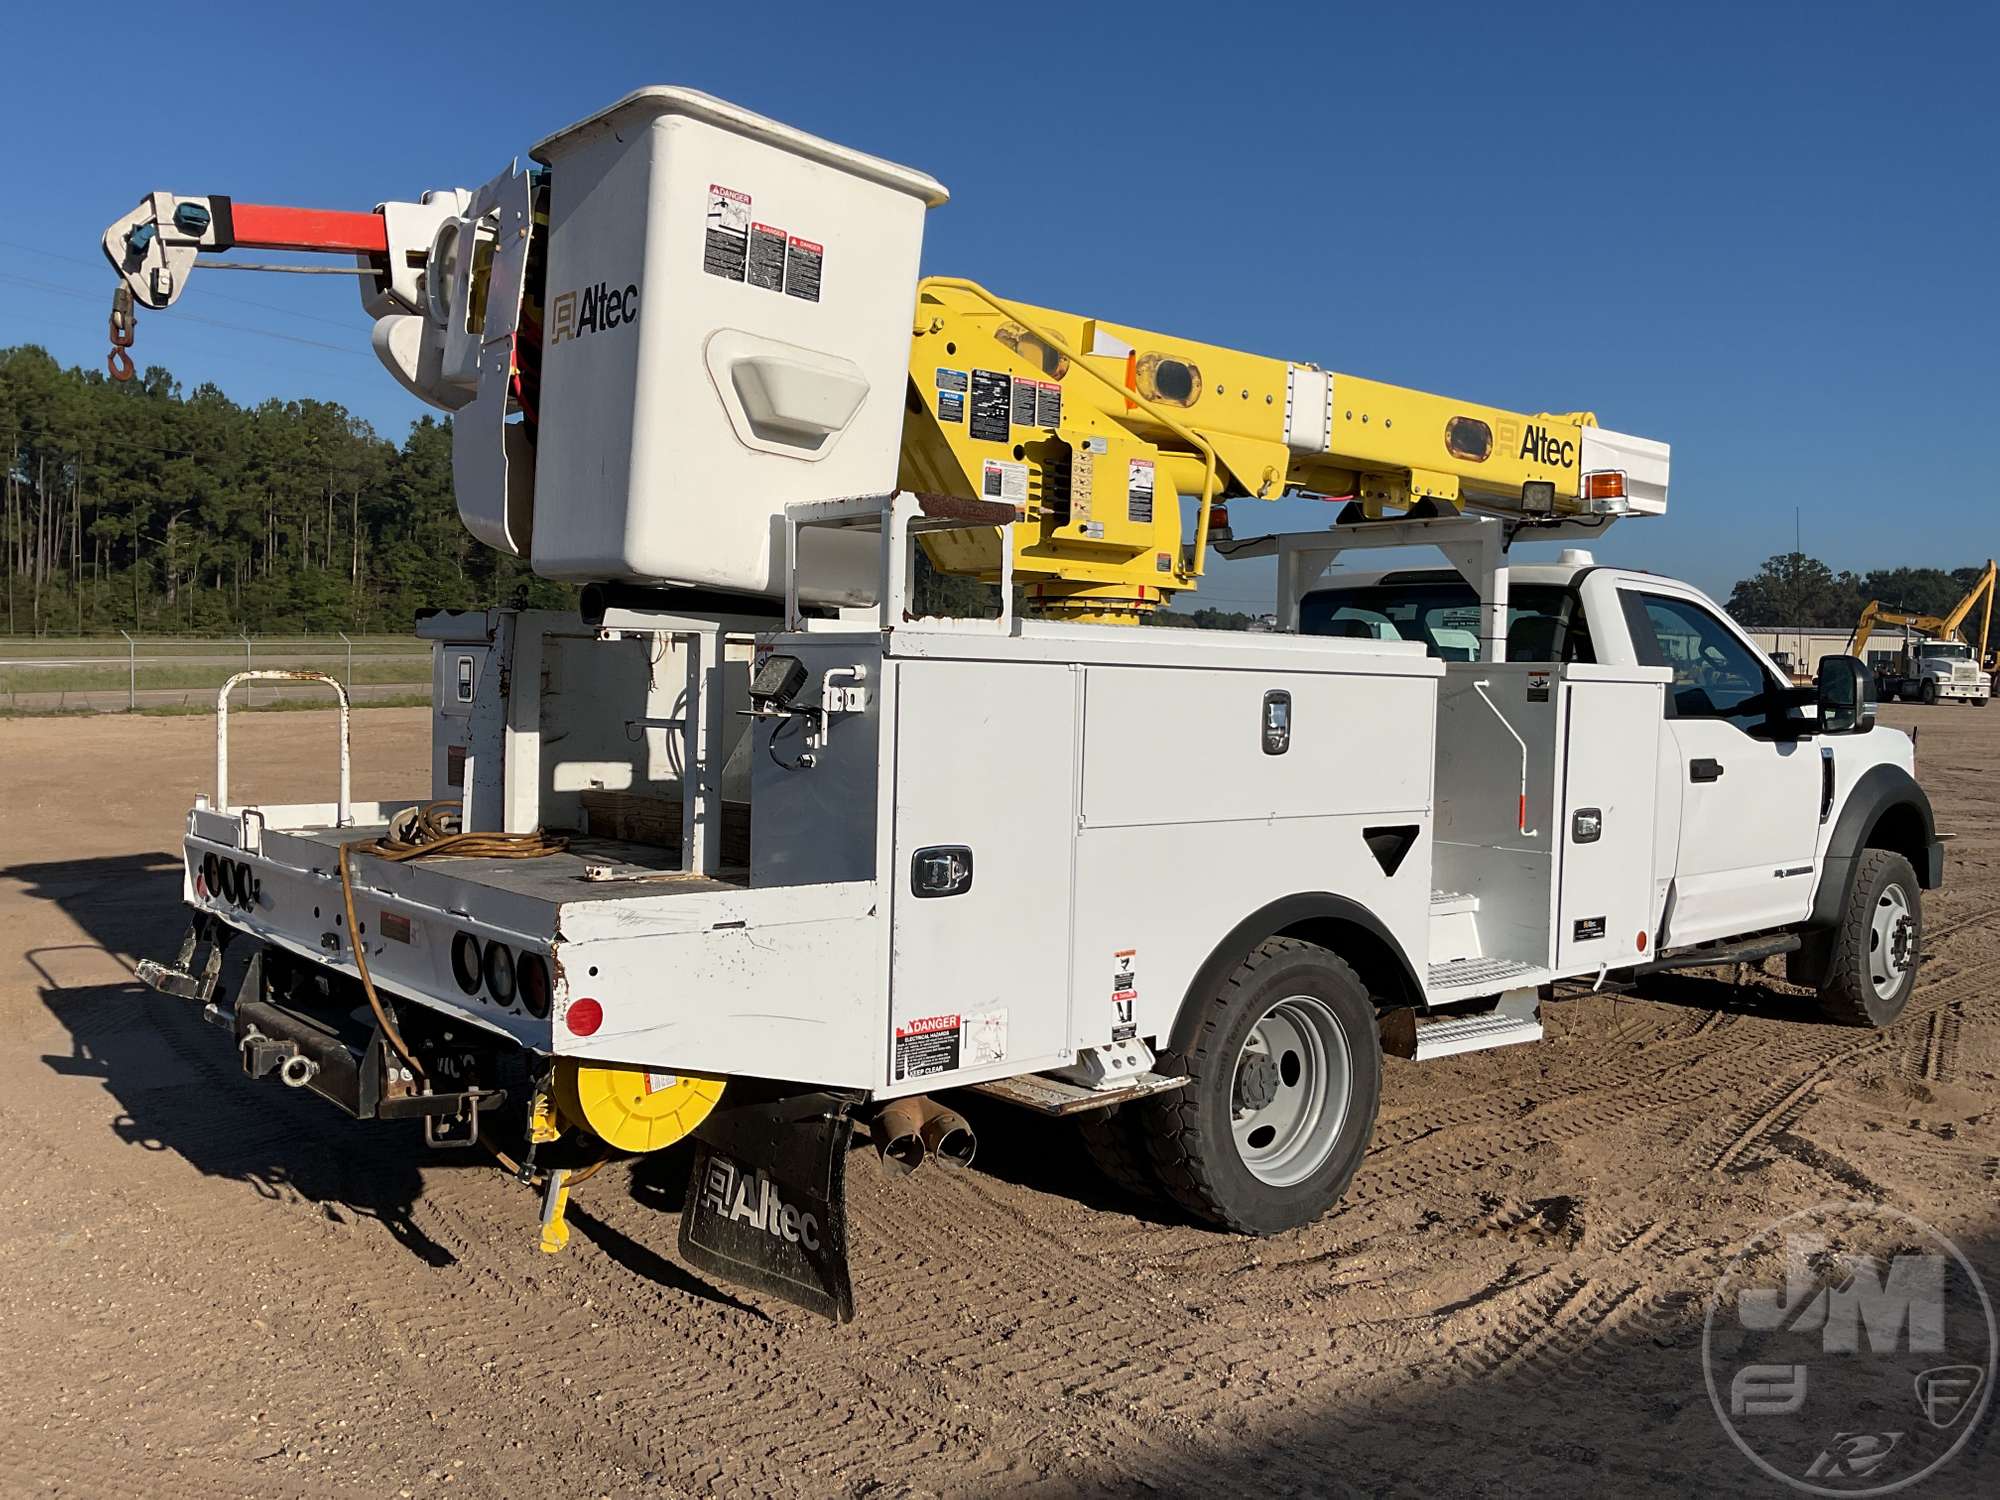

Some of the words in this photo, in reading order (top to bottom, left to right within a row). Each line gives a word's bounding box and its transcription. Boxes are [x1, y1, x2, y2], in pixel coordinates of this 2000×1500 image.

[719, 187, 750, 204] DANGER
[762, 226, 785, 238] DANGER
[799, 241, 821, 251] DANGER
[576, 281, 638, 338] Altec
[1519, 424, 1574, 468] Altec
[914, 1016, 957, 1033] DANGER
[909, 1069, 924, 1077] KEEP
[925, 1065, 943, 1074] CLEAR
[730, 1174, 820, 1251] Altec
